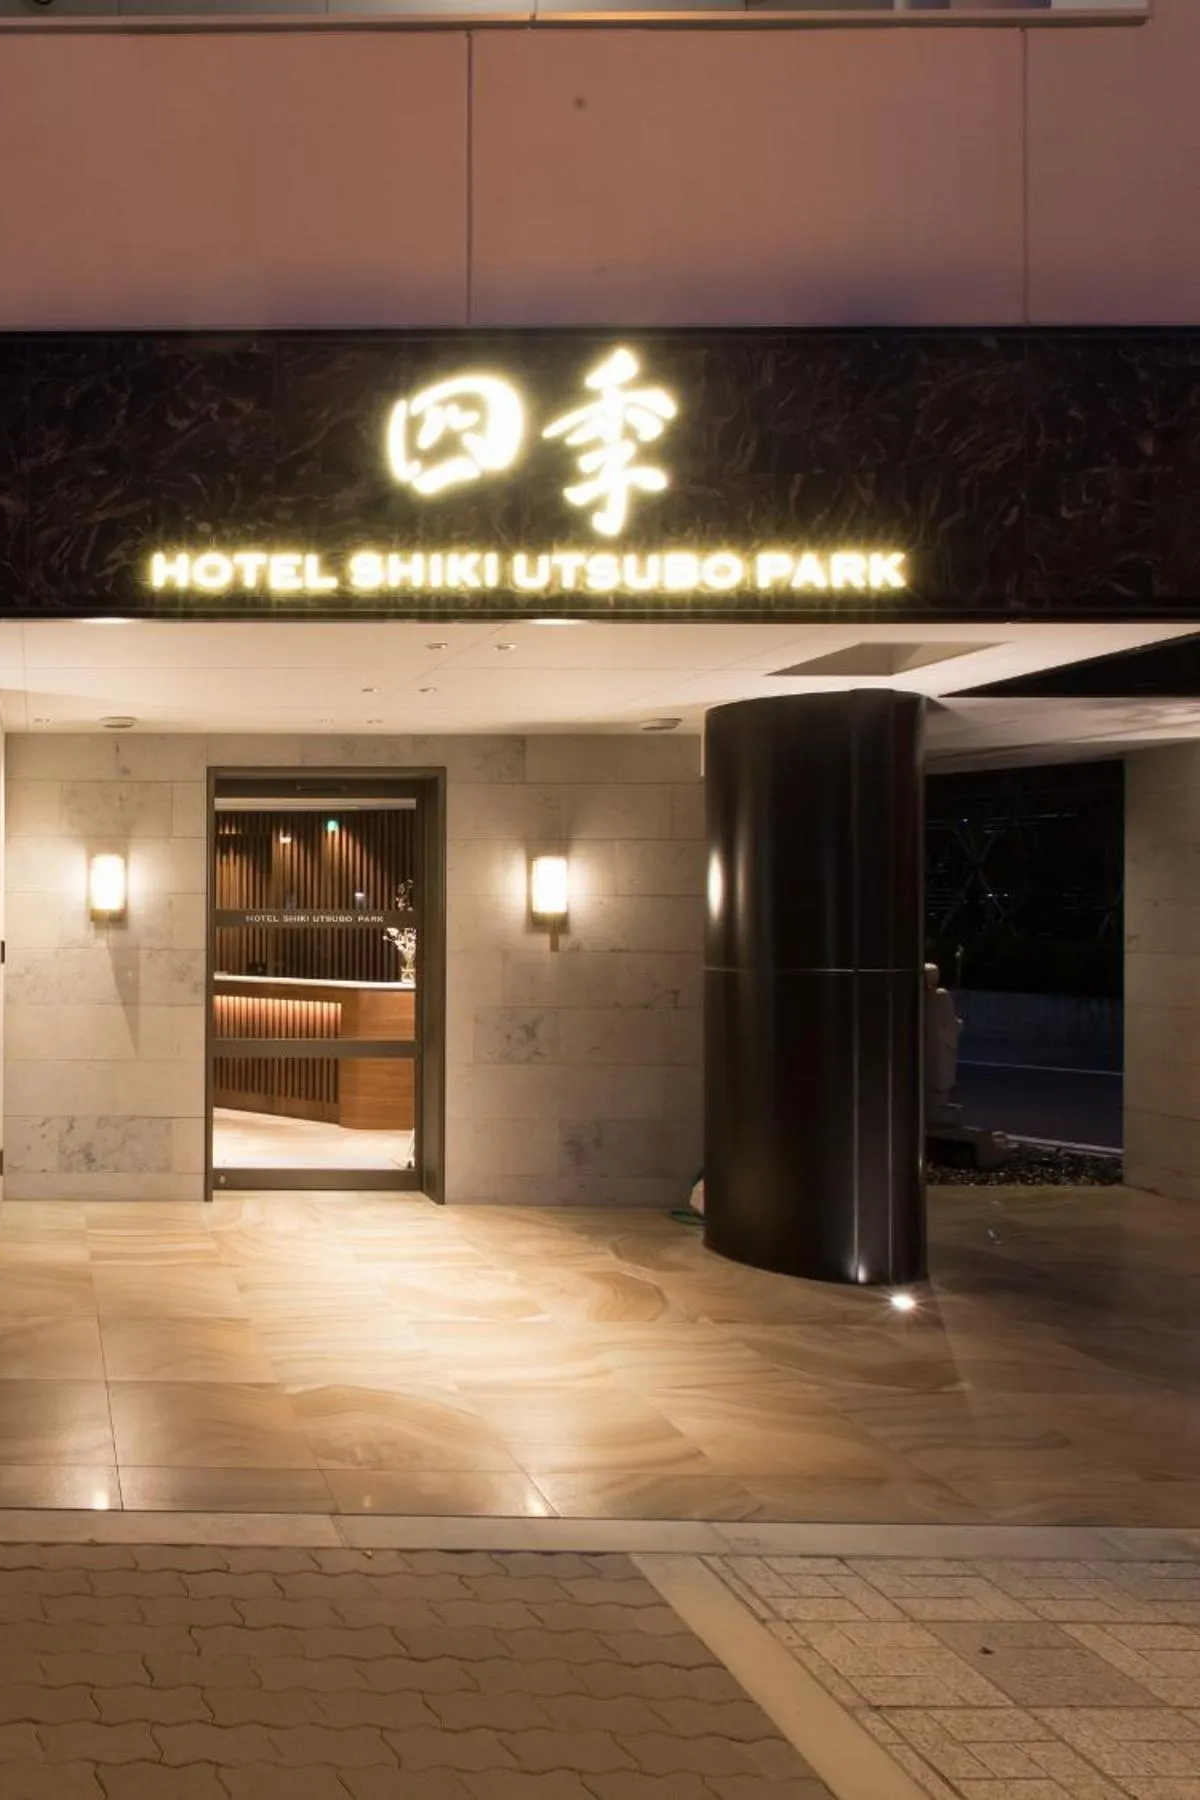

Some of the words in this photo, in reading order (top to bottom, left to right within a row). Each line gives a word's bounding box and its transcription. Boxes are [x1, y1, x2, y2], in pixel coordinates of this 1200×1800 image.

[387, 346, 677, 537] 四季
[151, 551, 337, 590] HOTEL
[349, 551, 499, 590] SHIKI
[512, 551, 744, 590] UTSUBO
[756, 551, 907, 590] PARK
[246, 914, 279, 923] HOTEL
[283, 914, 309, 923] SHIKI
[313, 914, 353, 923] UTSUBO
[358, 914, 383, 923] PARK
